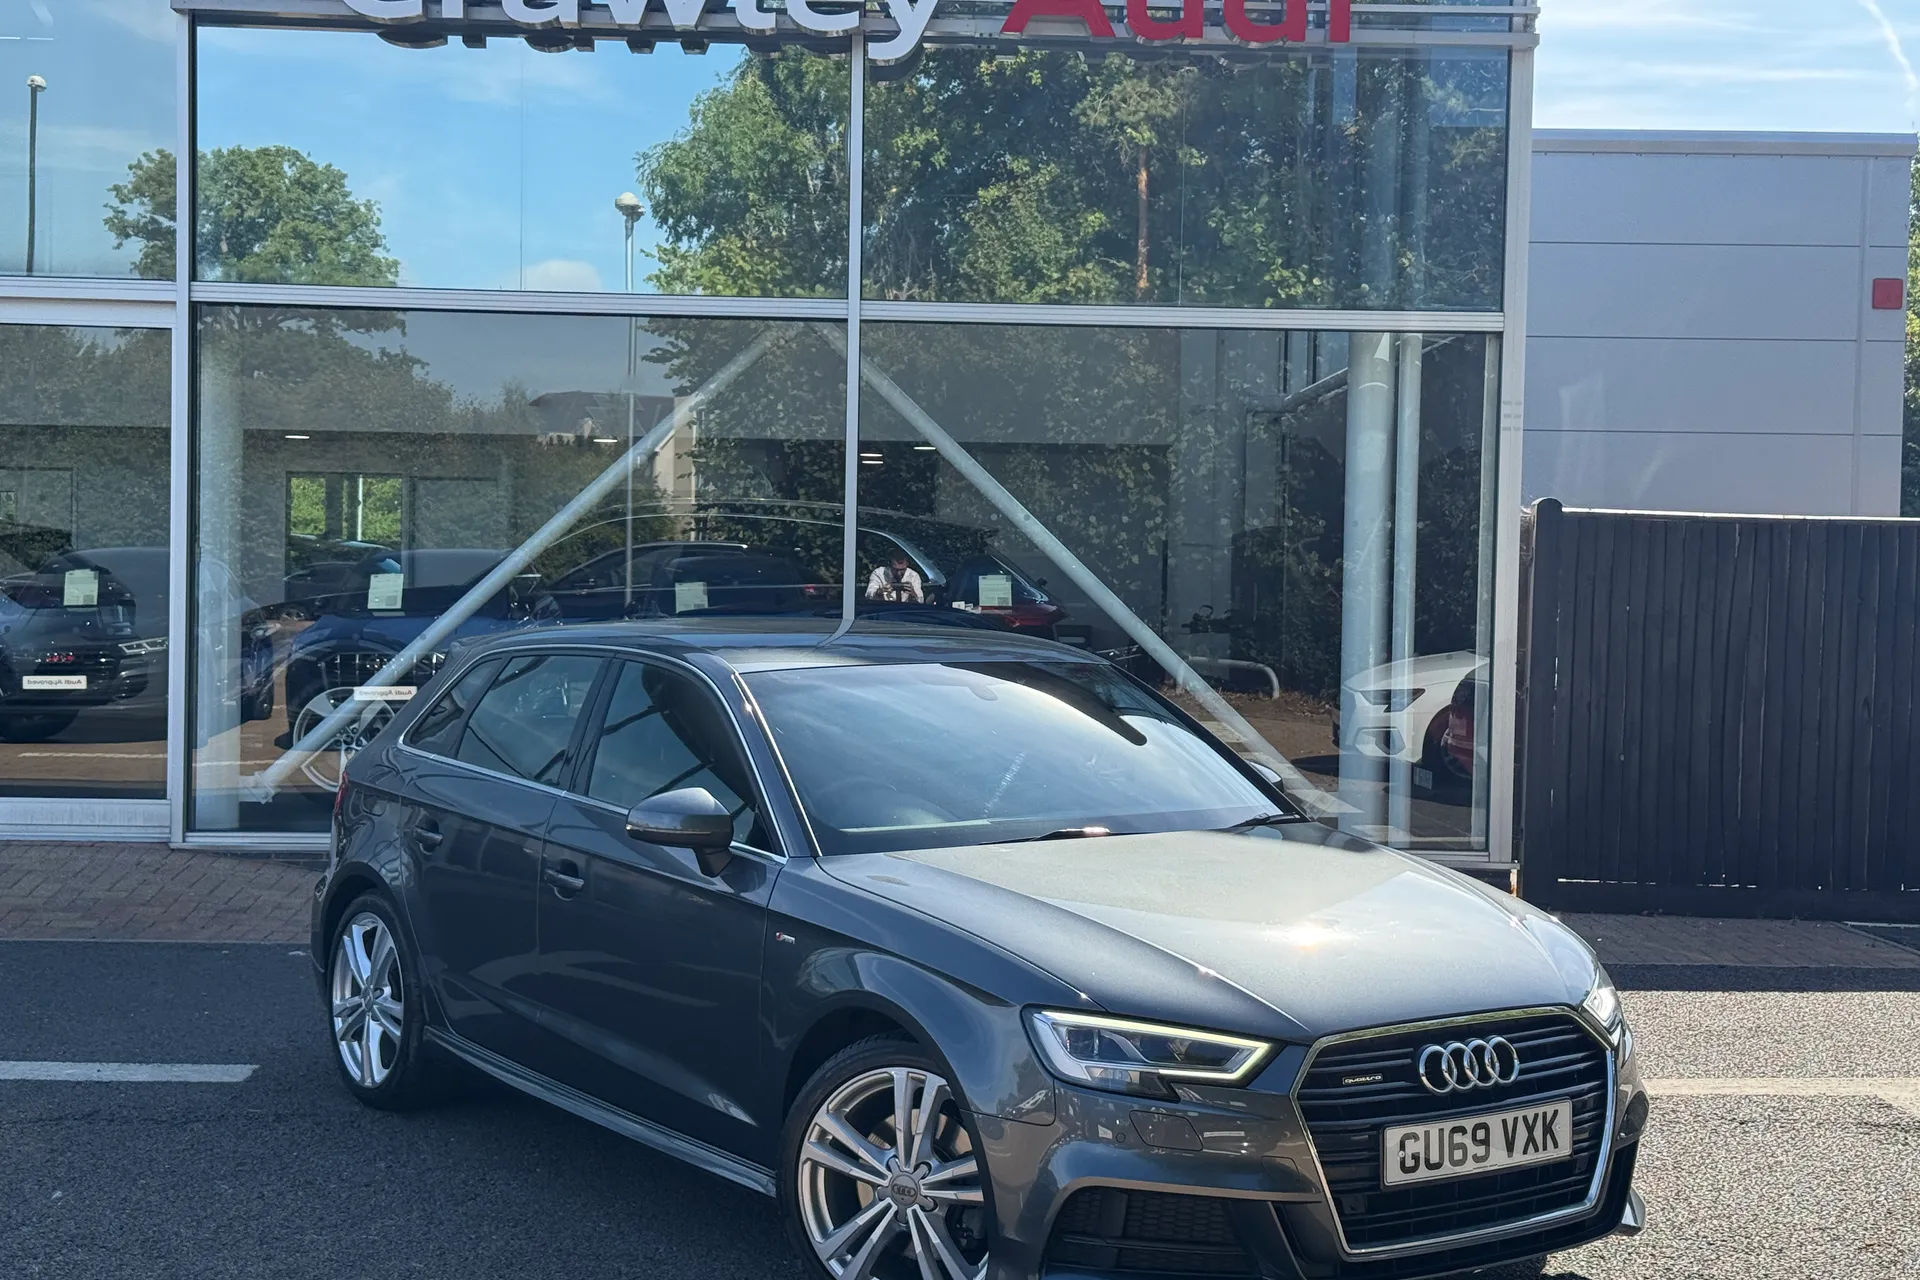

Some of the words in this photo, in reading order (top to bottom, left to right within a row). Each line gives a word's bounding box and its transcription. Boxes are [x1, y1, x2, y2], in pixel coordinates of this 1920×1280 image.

[1344, 1075, 1382, 1084] quattro
[1399, 1121, 1491, 1174] GU69
[1501, 1108, 1559, 1159] VXK
